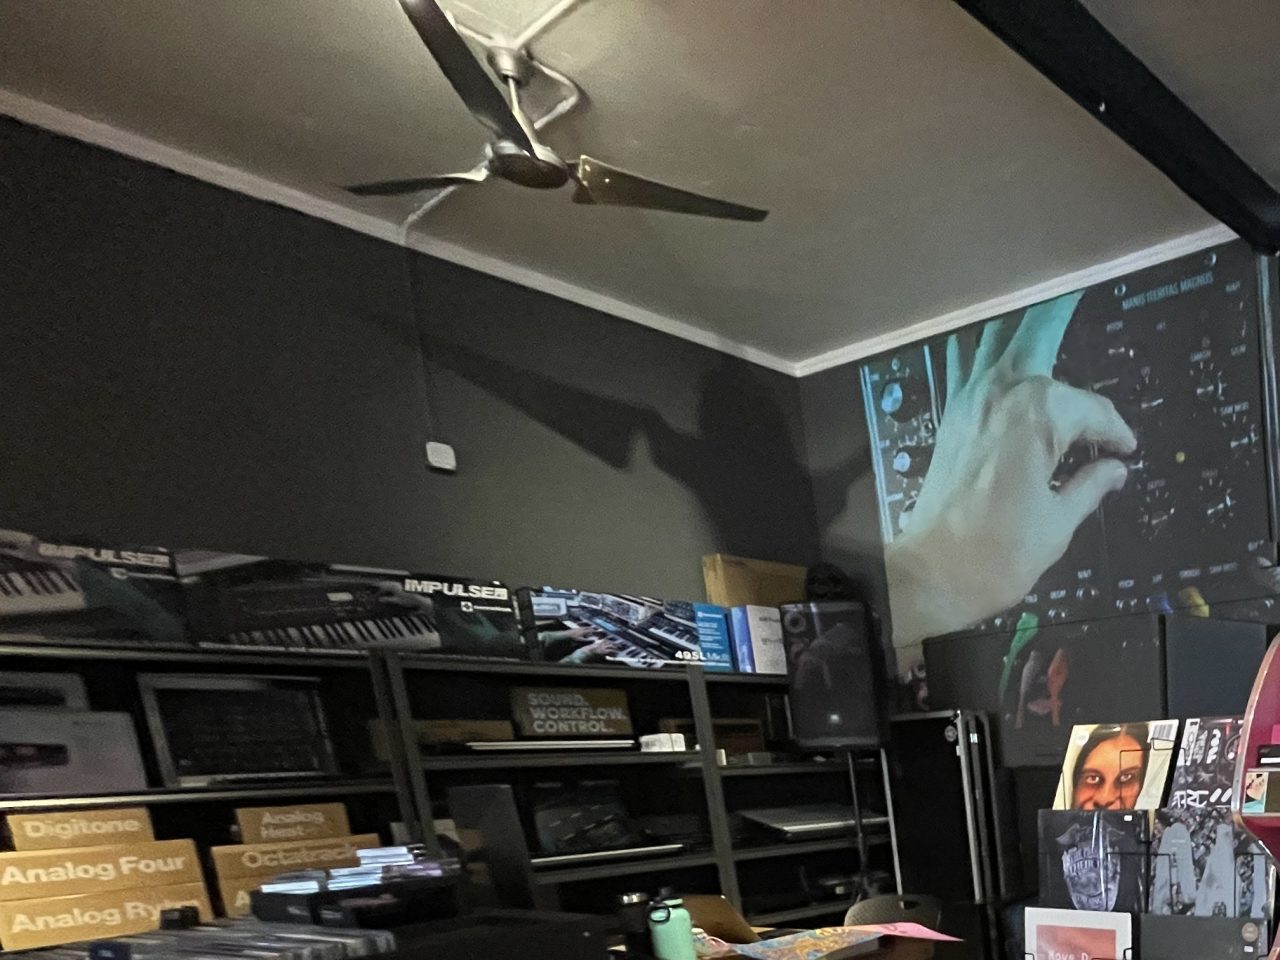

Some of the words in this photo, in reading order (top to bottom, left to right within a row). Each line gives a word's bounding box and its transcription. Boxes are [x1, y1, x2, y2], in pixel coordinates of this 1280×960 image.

[22, 818, 141, 838] Digitone
[0, 861, 117, 886] Analog
[119, 856, 187, 875] Four
[11, 907, 122, 934] Analog
